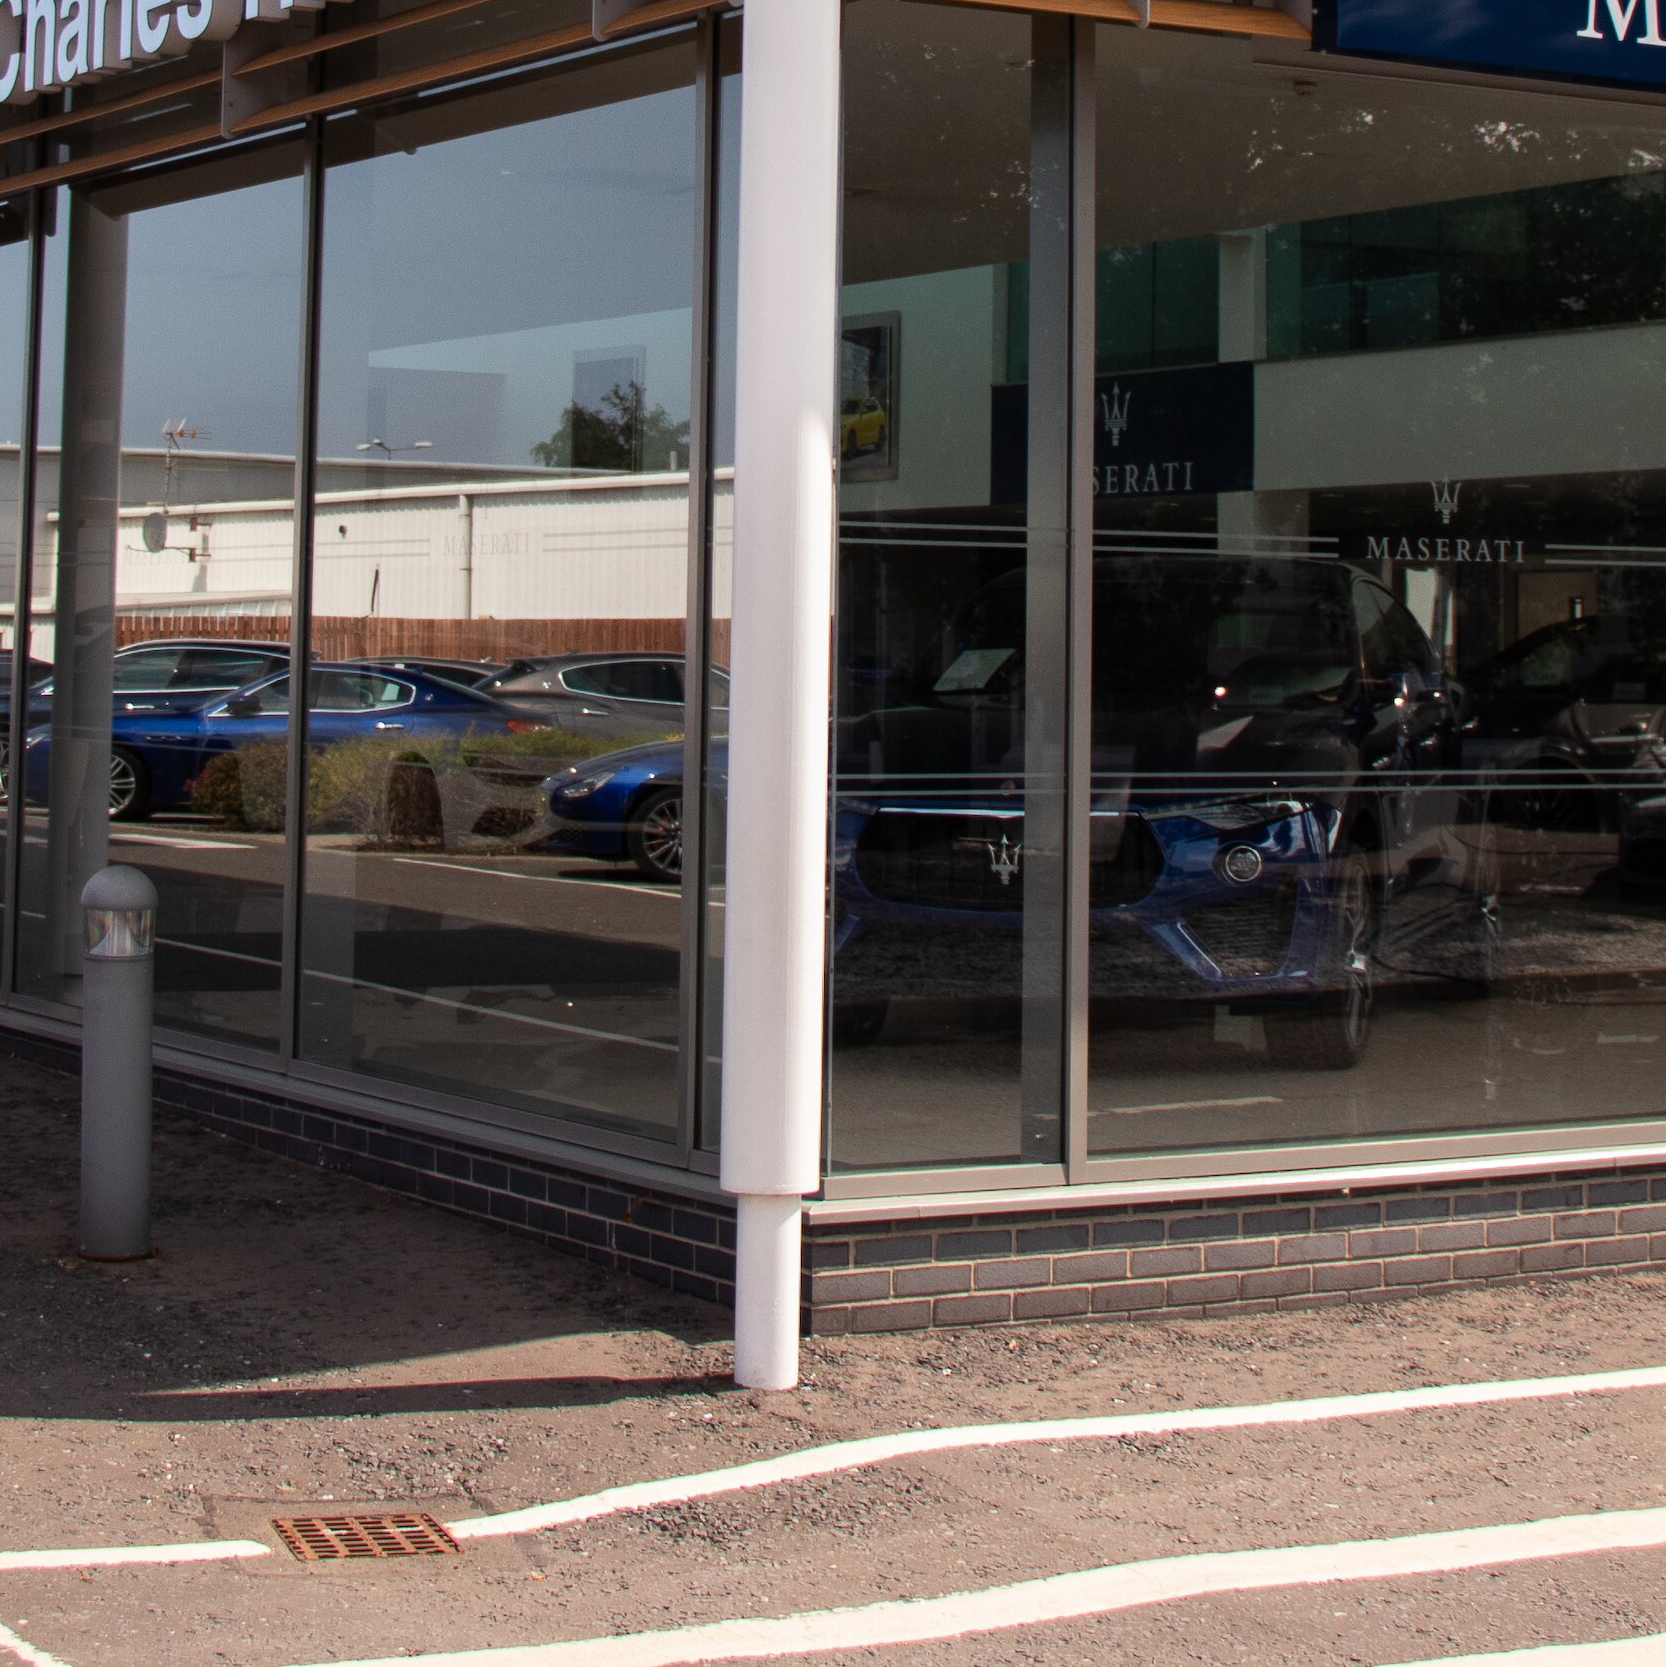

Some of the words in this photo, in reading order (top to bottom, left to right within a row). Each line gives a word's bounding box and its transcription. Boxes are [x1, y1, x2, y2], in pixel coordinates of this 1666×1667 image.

[1093, 461, 1195, 496] SERATI
[442, 532, 532, 558] MASERATI
[1365, 535, 1526, 564] MASERATI
